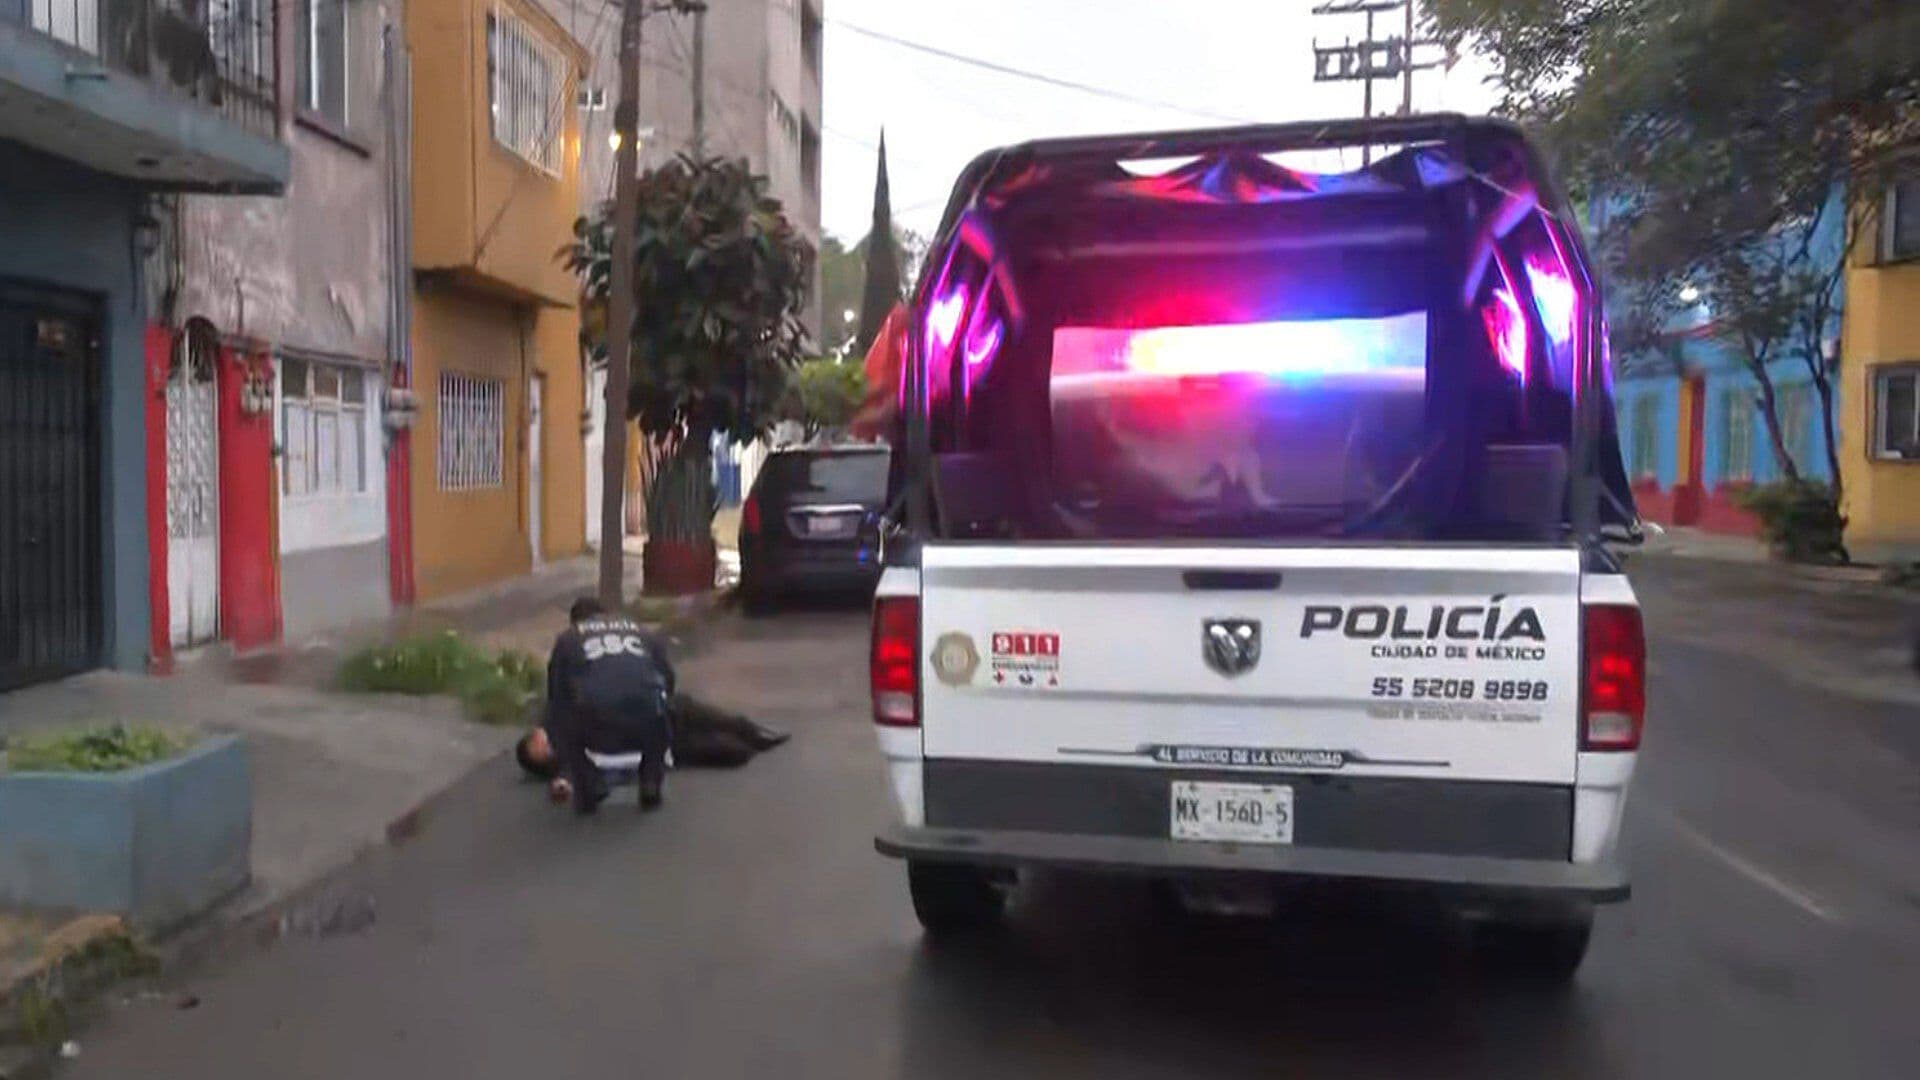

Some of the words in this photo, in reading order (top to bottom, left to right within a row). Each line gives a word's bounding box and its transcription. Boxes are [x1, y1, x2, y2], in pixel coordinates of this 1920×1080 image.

[1300, 594, 1546, 641] POLICÍA
[583, 633, 645, 659] SSC
[994, 634, 1056, 655] 911
[1371, 645, 1438, 659] CIUDAD
[1445, 646, 1468, 660] DE
[1475, 644, 1546, 661] MÉXICO
[1371, 676, 1404, 697] 55
[1411, 679, 1475, 700] 5208
[1483, 680, 1549, 701] 9898
[1231, 749, 1249, 764] DE
[1251, 750, 1268, 765] LA
